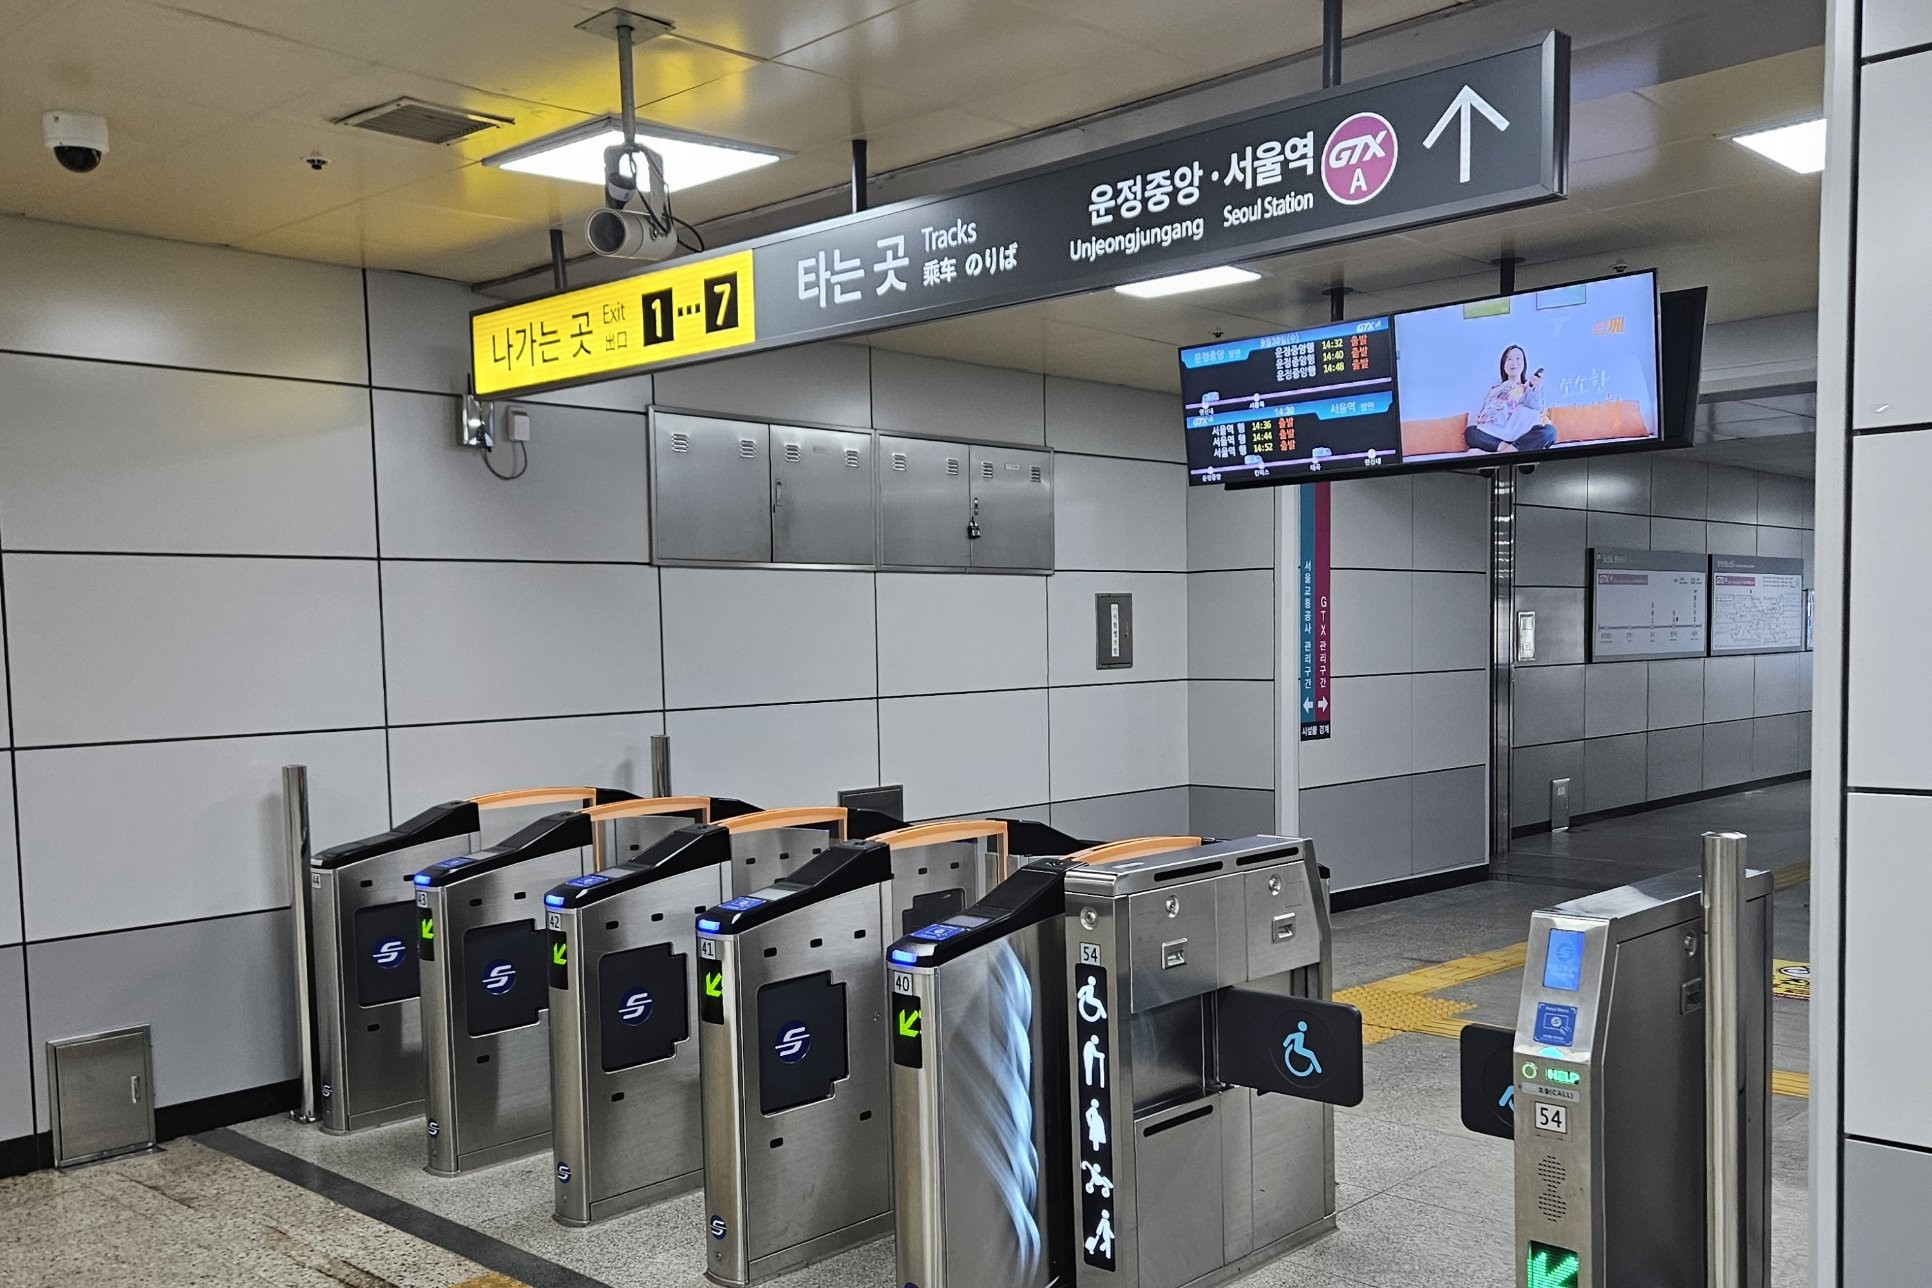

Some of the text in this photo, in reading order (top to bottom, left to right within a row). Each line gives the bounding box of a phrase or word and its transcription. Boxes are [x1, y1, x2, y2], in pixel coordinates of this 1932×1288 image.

[1328, 129, 1387, 169] GTX
[1349, 167, 1368, 195] A
[921, 218, 977, 252] Tracks
[1070, 191, 1314, 262] Unjeongjungang Seoul Station
[965, 241, 1019, 277] のりば
[797, 234, 910, 308] 타는 곳
[602, 301, 626, 325] Exit
[491, 311, 593, 371] 나가는 곳
[605, 330, 628, 352] 出口
[1275, 335, 1368, 358] 운정중앙행 14:32 출발
[1194, 348, 1225, 364] 운정중앙
[1276, 346, 1368, 370] 운정중앙행 14:40 출발
[1276, 359, 1369, 381] 운정중앙행 14:48 출발
[1274, 406, 1295, 416] 14:30
[1330, 401, 1356, 414] 서울역
[1212, 417, 1294, 436] 서울역 행 14:36 출발
[1212, 428, 1295, 447] 서울역 행 14:44 출발
[1213, 440, 1296, 458] 서울역 행 14:52 출발
[1304, 560, 1312, 689] 서울교통공사 관리구간
[418, 893, 426, 906] 43
[550, 915, 560, 929] 42
[702, 941, 714, 957] 41
[1083, 946, 1098, 963] 54
[896, 974, 910, 992] 40
[1546, 1068, 1580, 1085] HELP
[1540, 1107, 1563, 1128] 54
